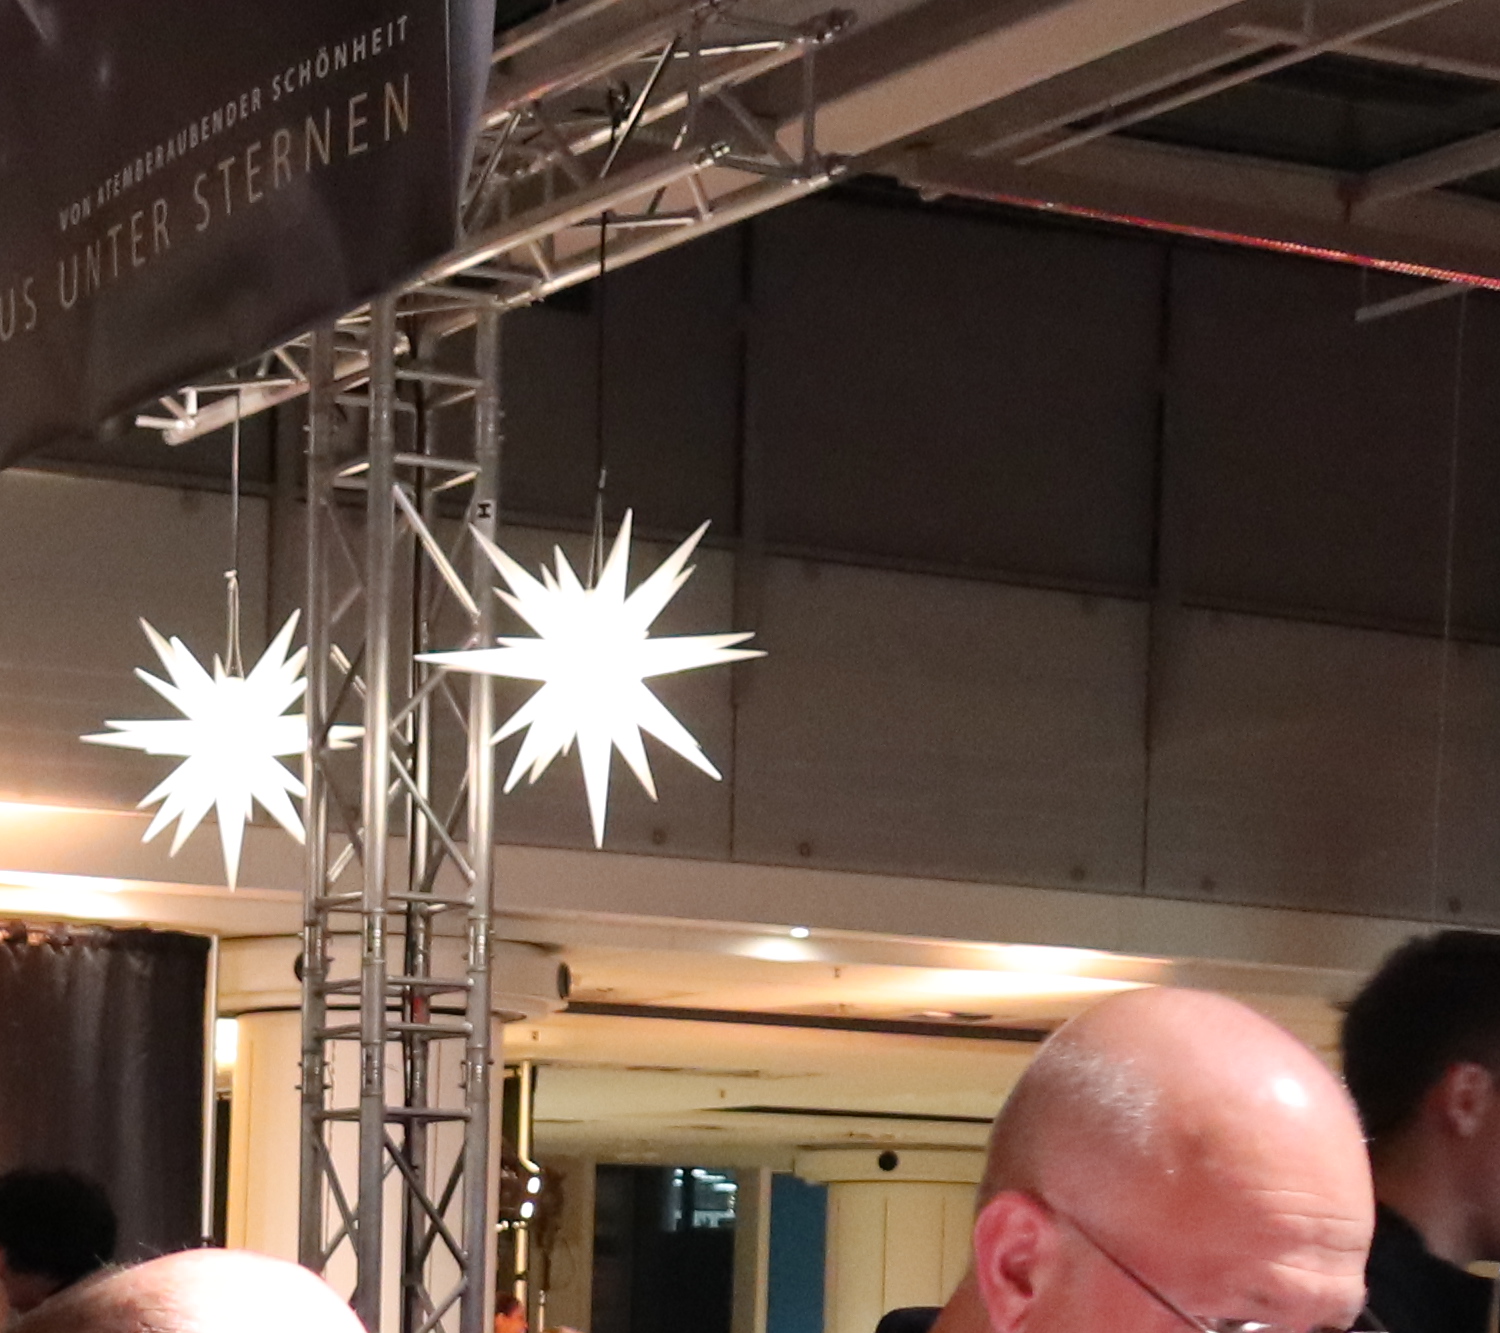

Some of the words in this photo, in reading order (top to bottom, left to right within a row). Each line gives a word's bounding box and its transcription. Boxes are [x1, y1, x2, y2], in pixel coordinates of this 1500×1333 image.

[58, 198, 170, 310] UNTER
[194, 74, 411, 232] STERNEN
[59, 196, 91, 231] VON
[271, 15, 409, 101] SCHÖNHEIT
